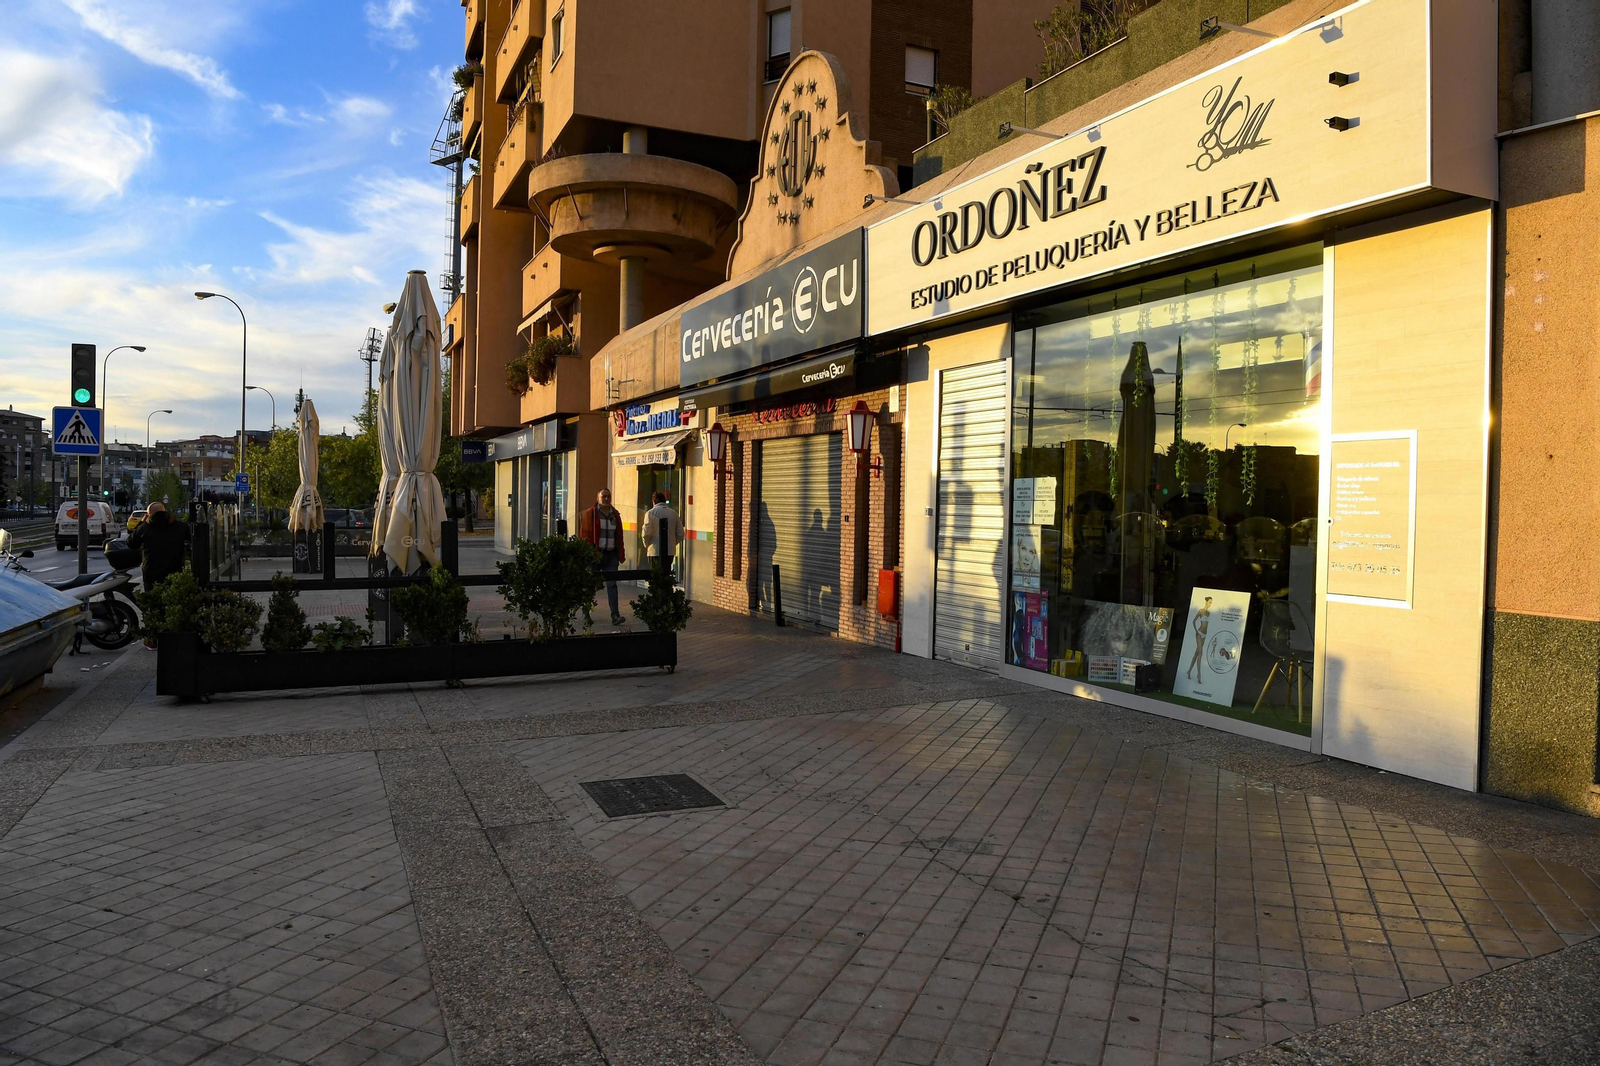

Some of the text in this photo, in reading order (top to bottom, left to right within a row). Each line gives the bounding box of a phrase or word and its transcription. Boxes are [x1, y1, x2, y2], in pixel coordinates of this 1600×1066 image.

[910, 176, 1280, 310] ESTUDIO DE PELUQUERÍA Y BELLEZA
[911, 145, 1108, 267] ORDOÑEZ
